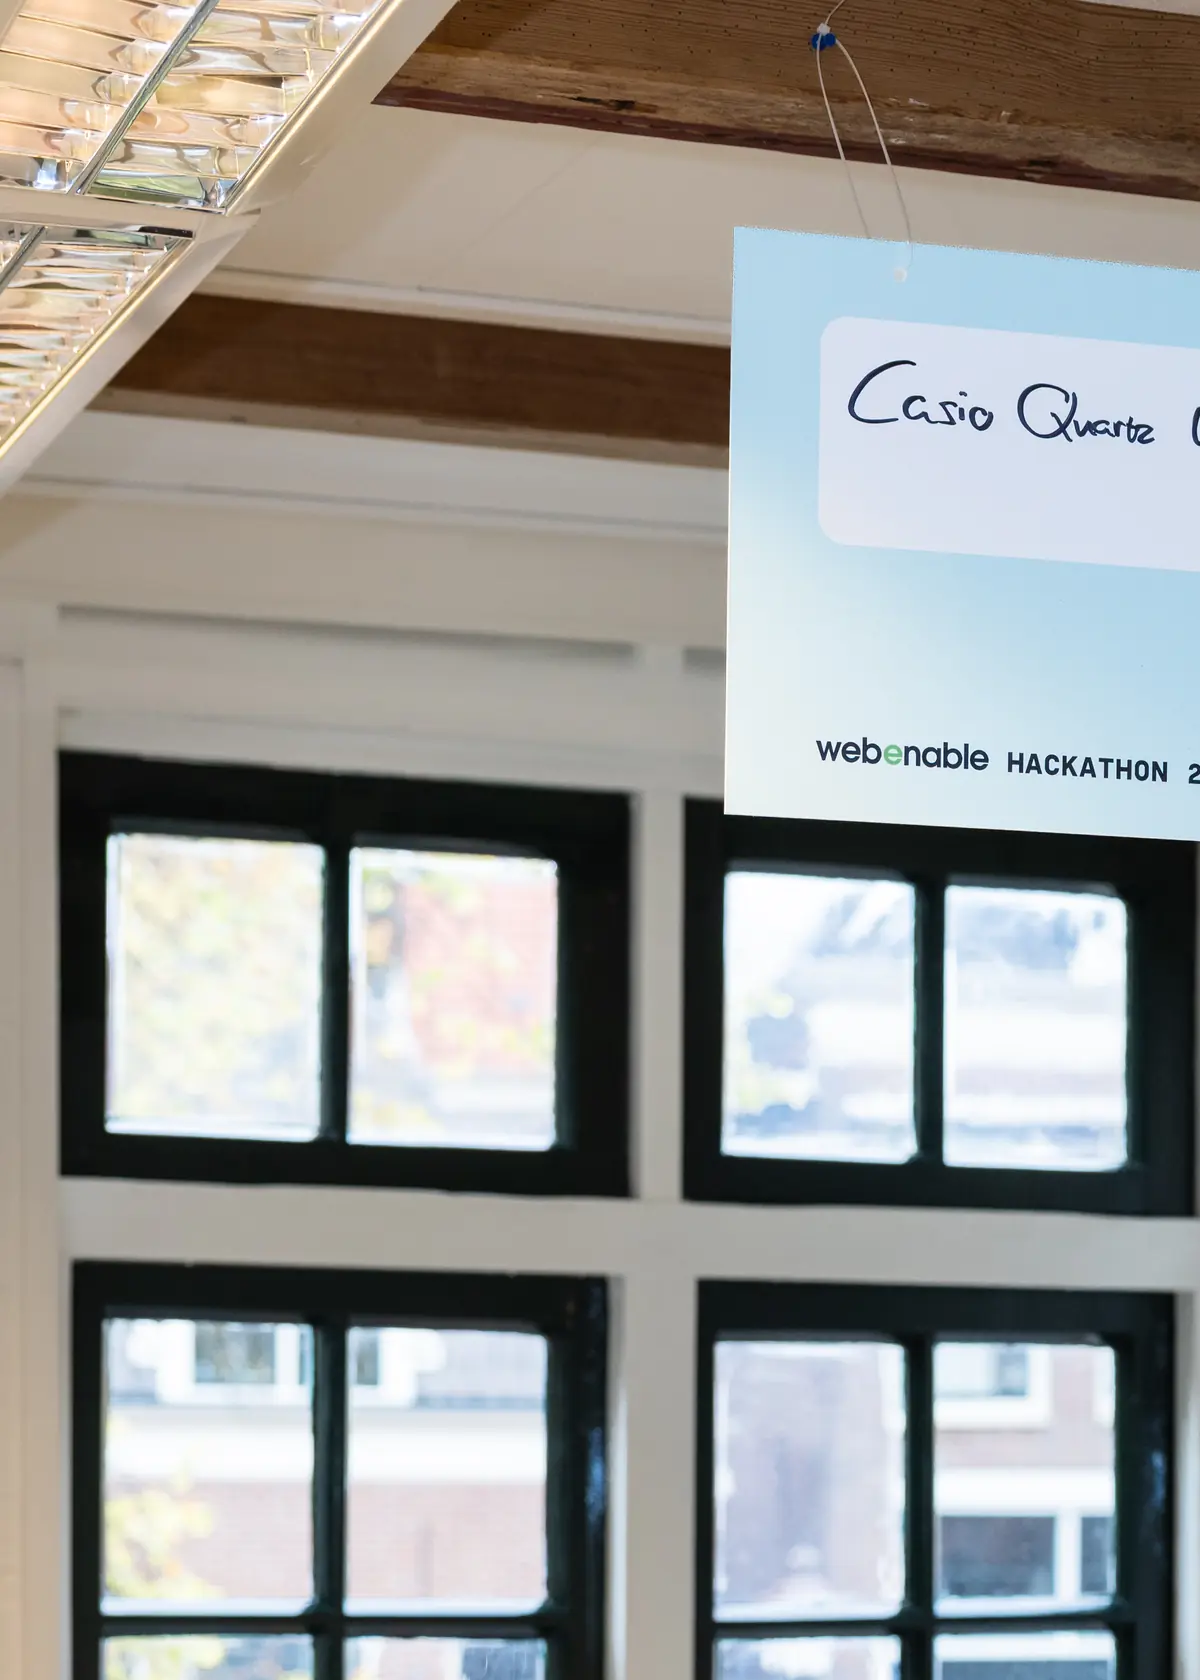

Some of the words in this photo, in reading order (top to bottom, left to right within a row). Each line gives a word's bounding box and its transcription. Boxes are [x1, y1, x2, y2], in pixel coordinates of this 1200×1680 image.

[848, 360, 994, 431] Casio
[1017, 383, 1155, 444] Quartz
[816, 737, 989, 771] webenable
[1008, 752, 1167, 782] HACKATHON
